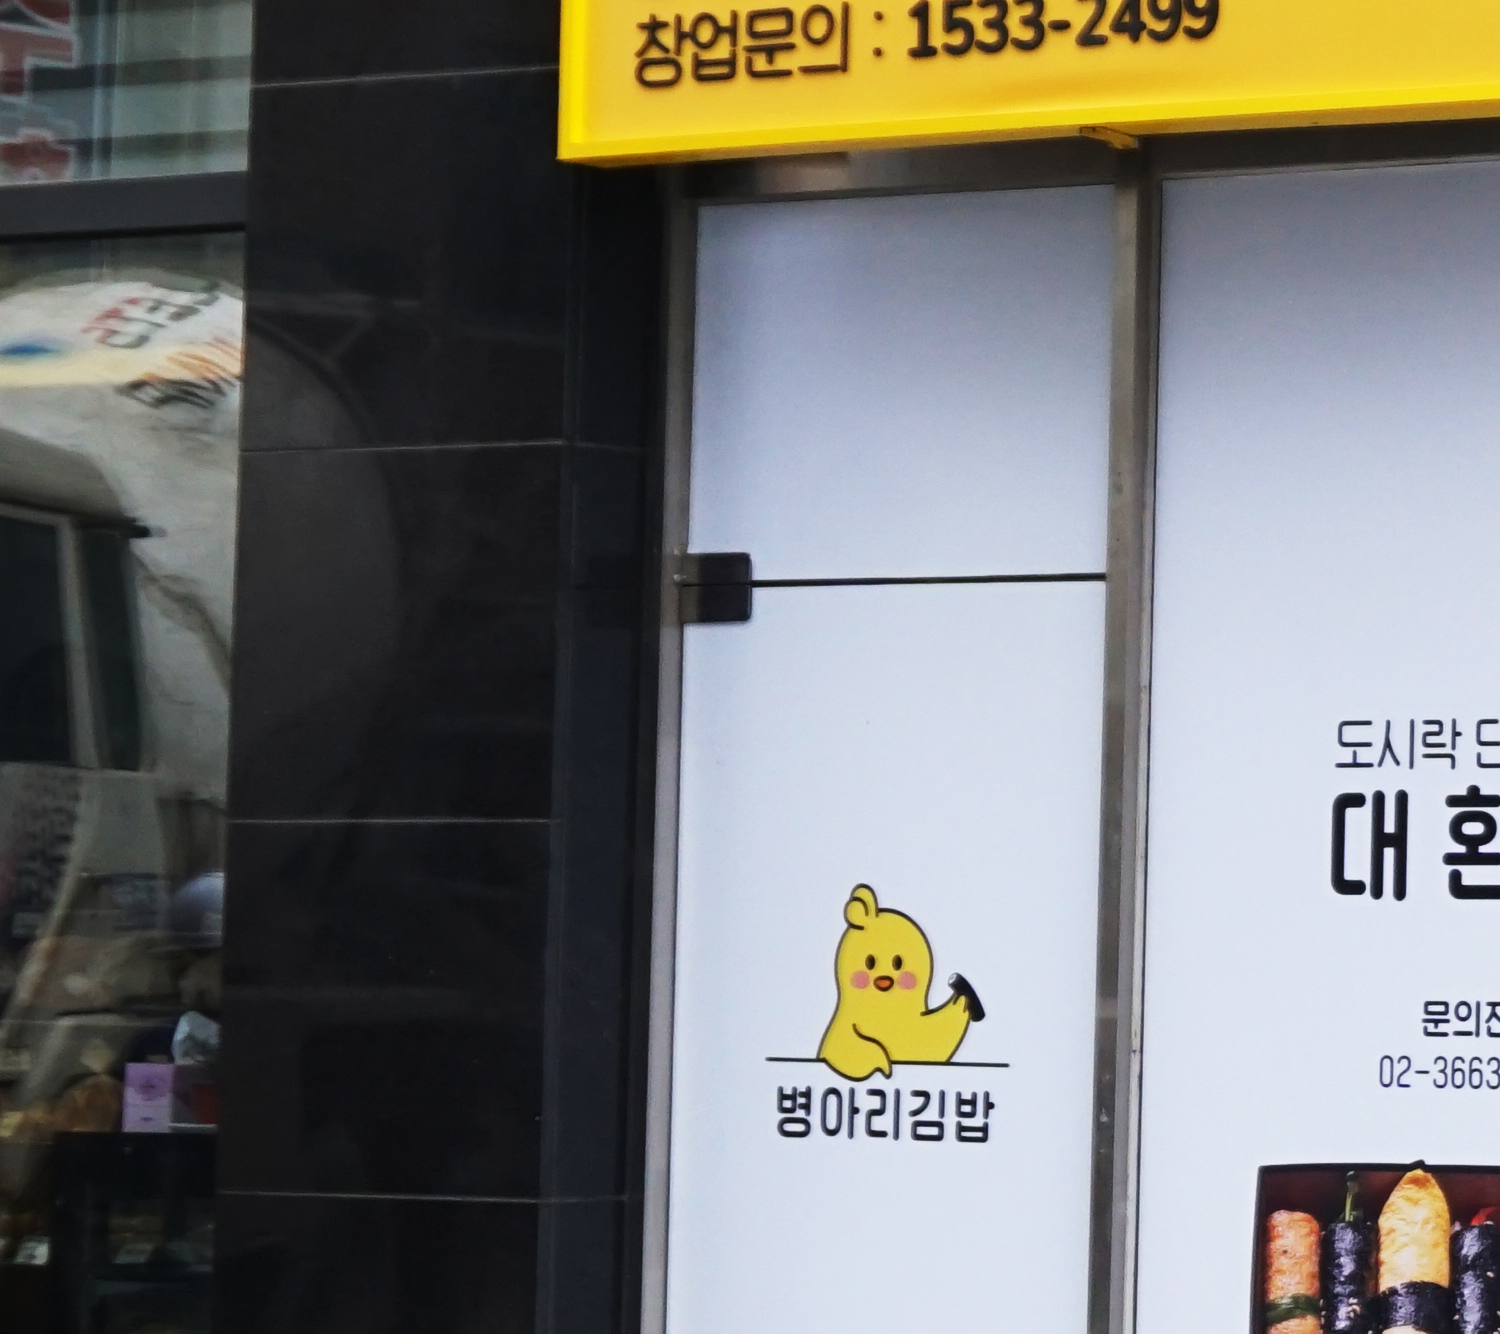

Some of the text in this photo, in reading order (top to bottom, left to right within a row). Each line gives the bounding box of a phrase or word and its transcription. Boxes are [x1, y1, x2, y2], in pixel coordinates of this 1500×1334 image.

[633, 2, 852, 91] 창업문의
[1333, 717, 1464, 771] 도시락
[775, 1083, 996, 1145] 병아리김밥
